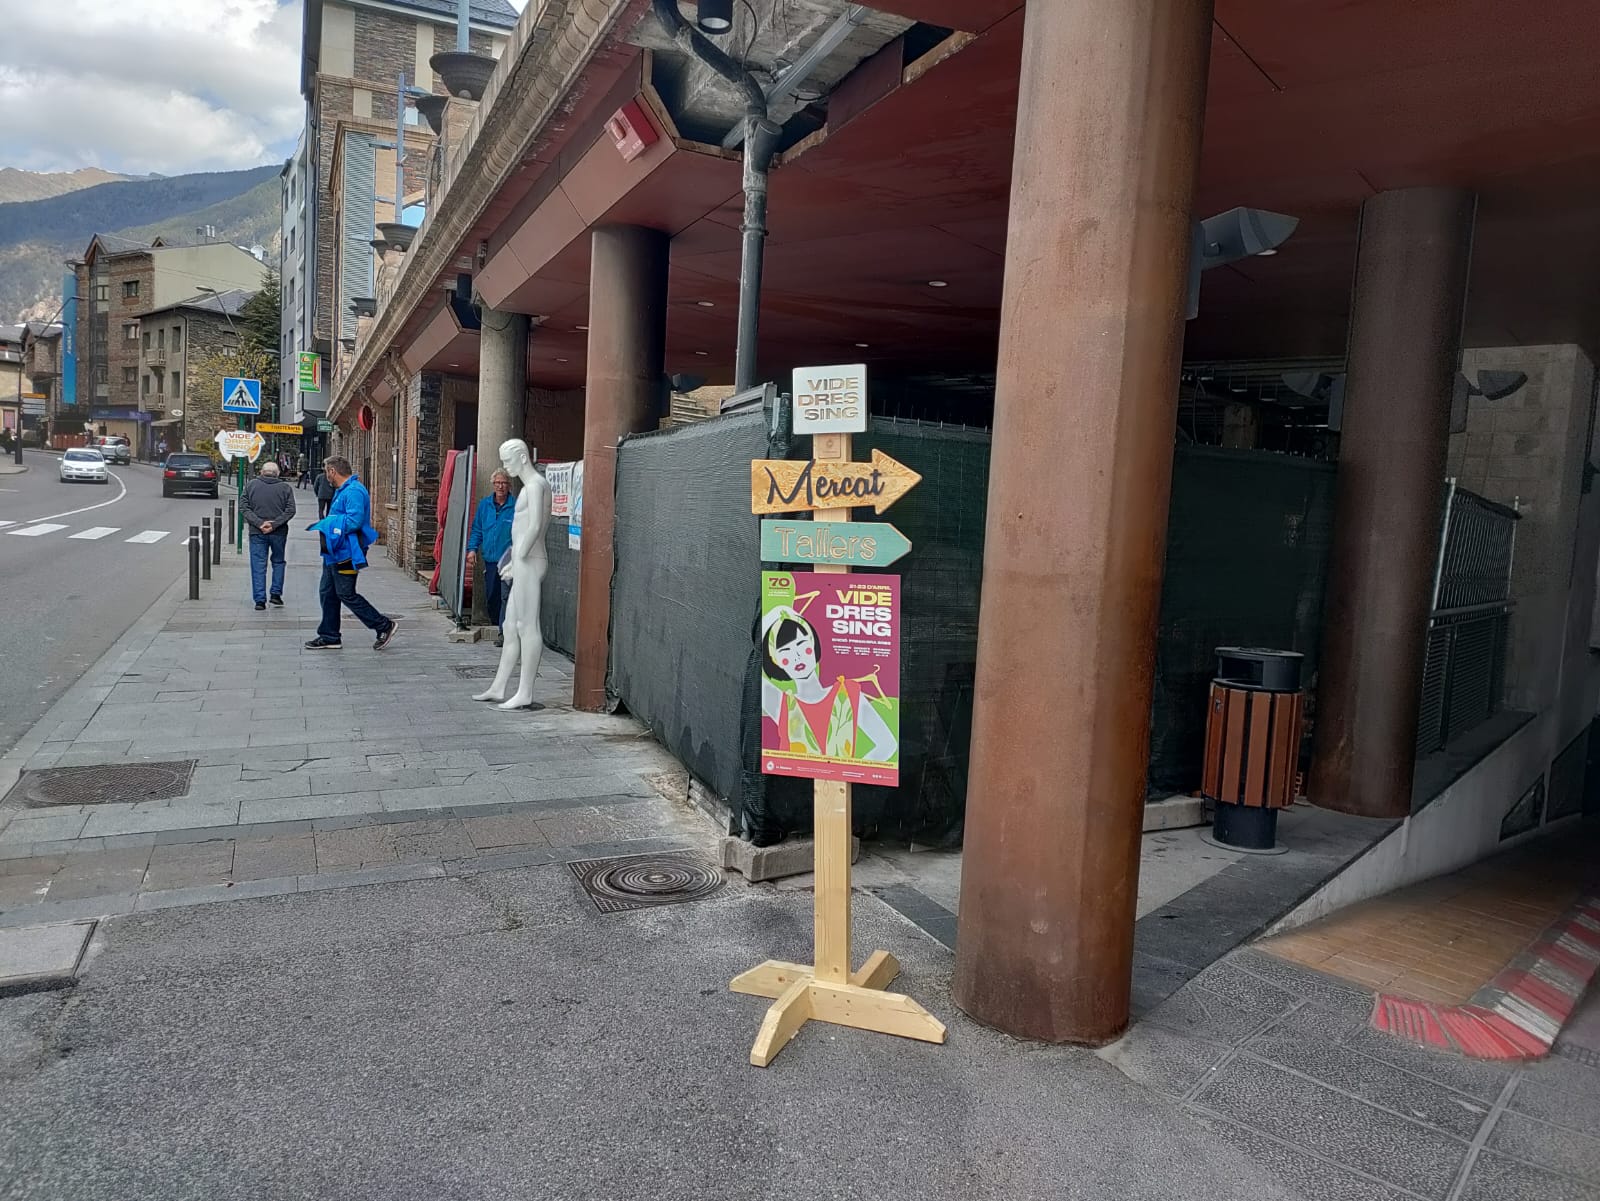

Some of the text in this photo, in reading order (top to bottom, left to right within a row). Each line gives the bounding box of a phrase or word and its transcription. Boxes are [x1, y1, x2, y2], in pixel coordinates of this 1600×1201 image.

[807, 377, 859, 391] VIDE
[798, 392, 859, 407] DRES
[804, 407, 859, 421] SING
[764, 459, 885, 506] Mercat
[774, 526, 877, 560] Tallers
[768, 577, 790, 587] 70
[836, 590, 892, 606] VIDE
[826, 604, 892, 621] DRES
[832, 619, 892, 637] SING
